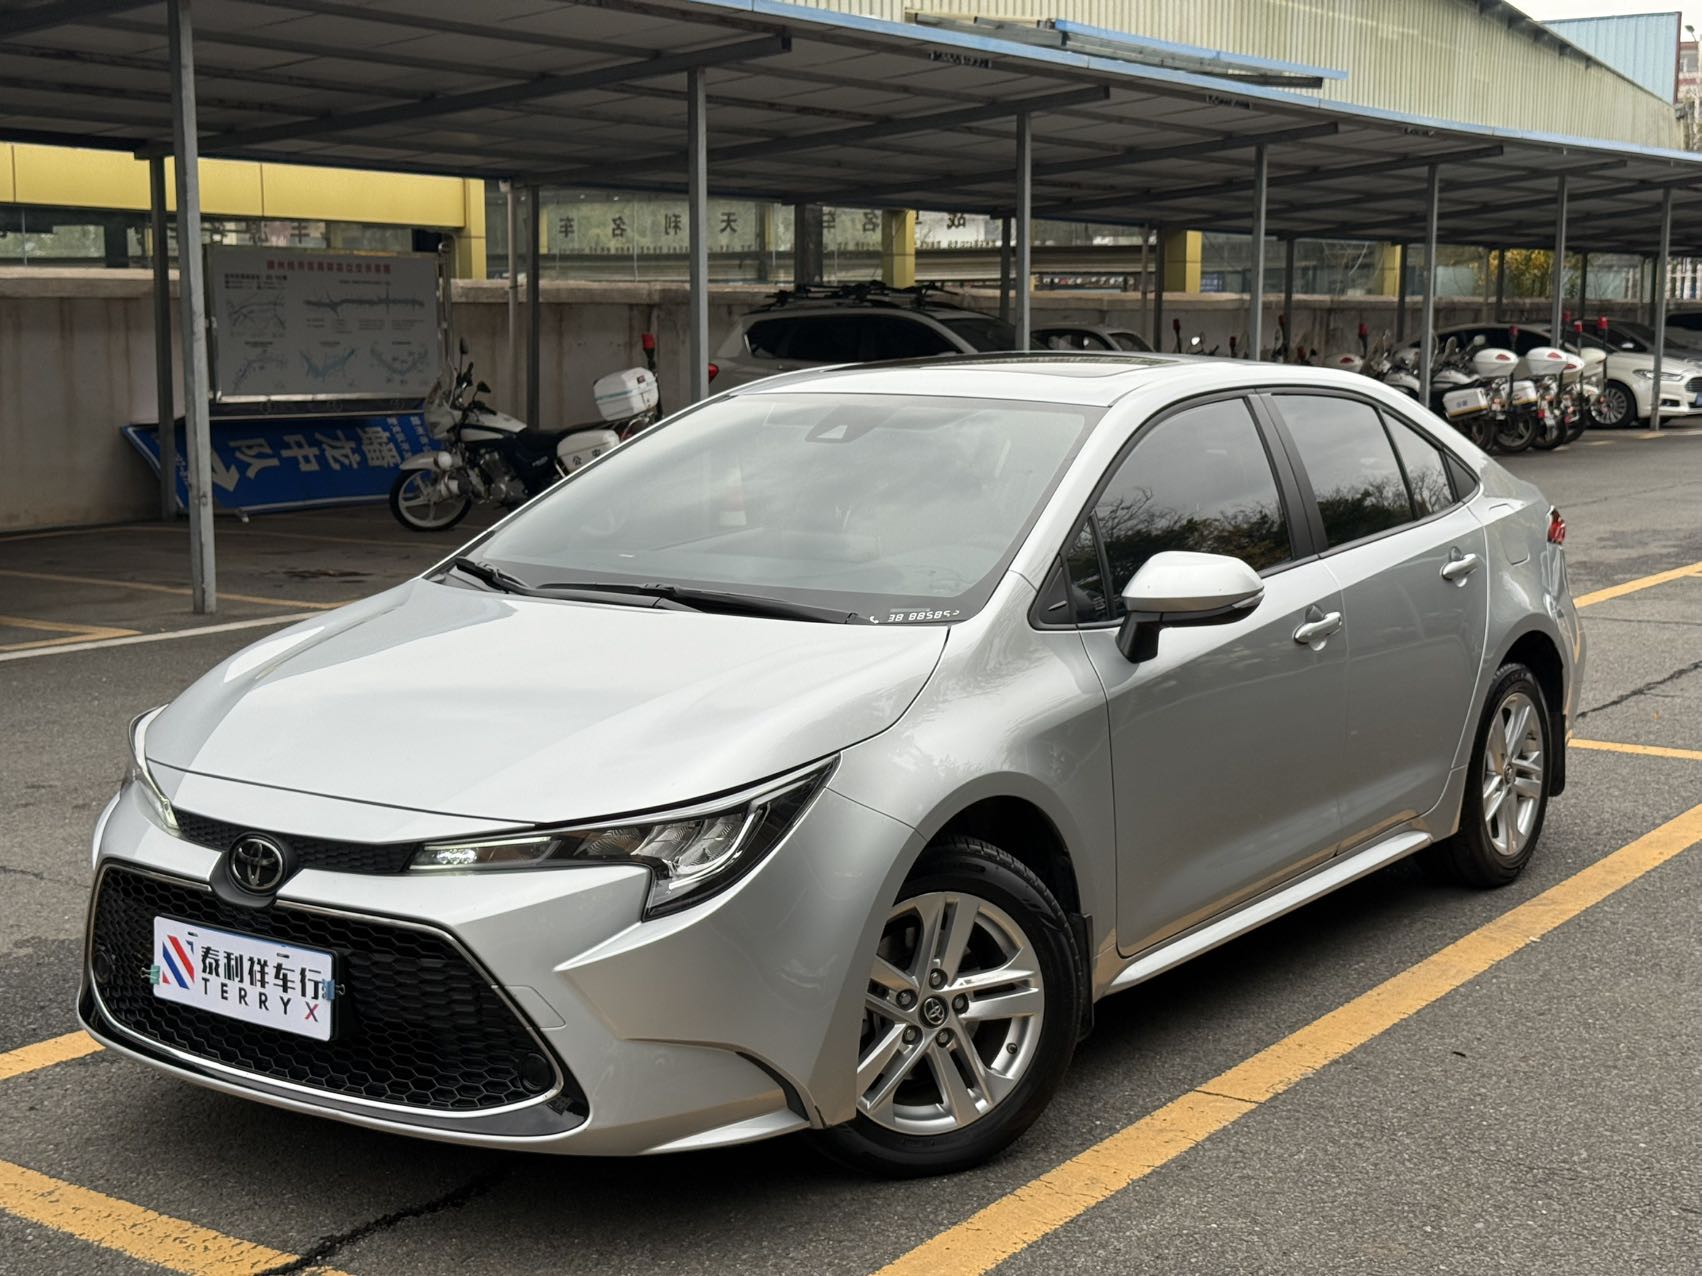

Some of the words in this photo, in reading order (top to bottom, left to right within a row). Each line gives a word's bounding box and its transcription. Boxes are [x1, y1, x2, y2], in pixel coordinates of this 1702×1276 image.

[200, 945, 323, 1000] 泰利祥车行
